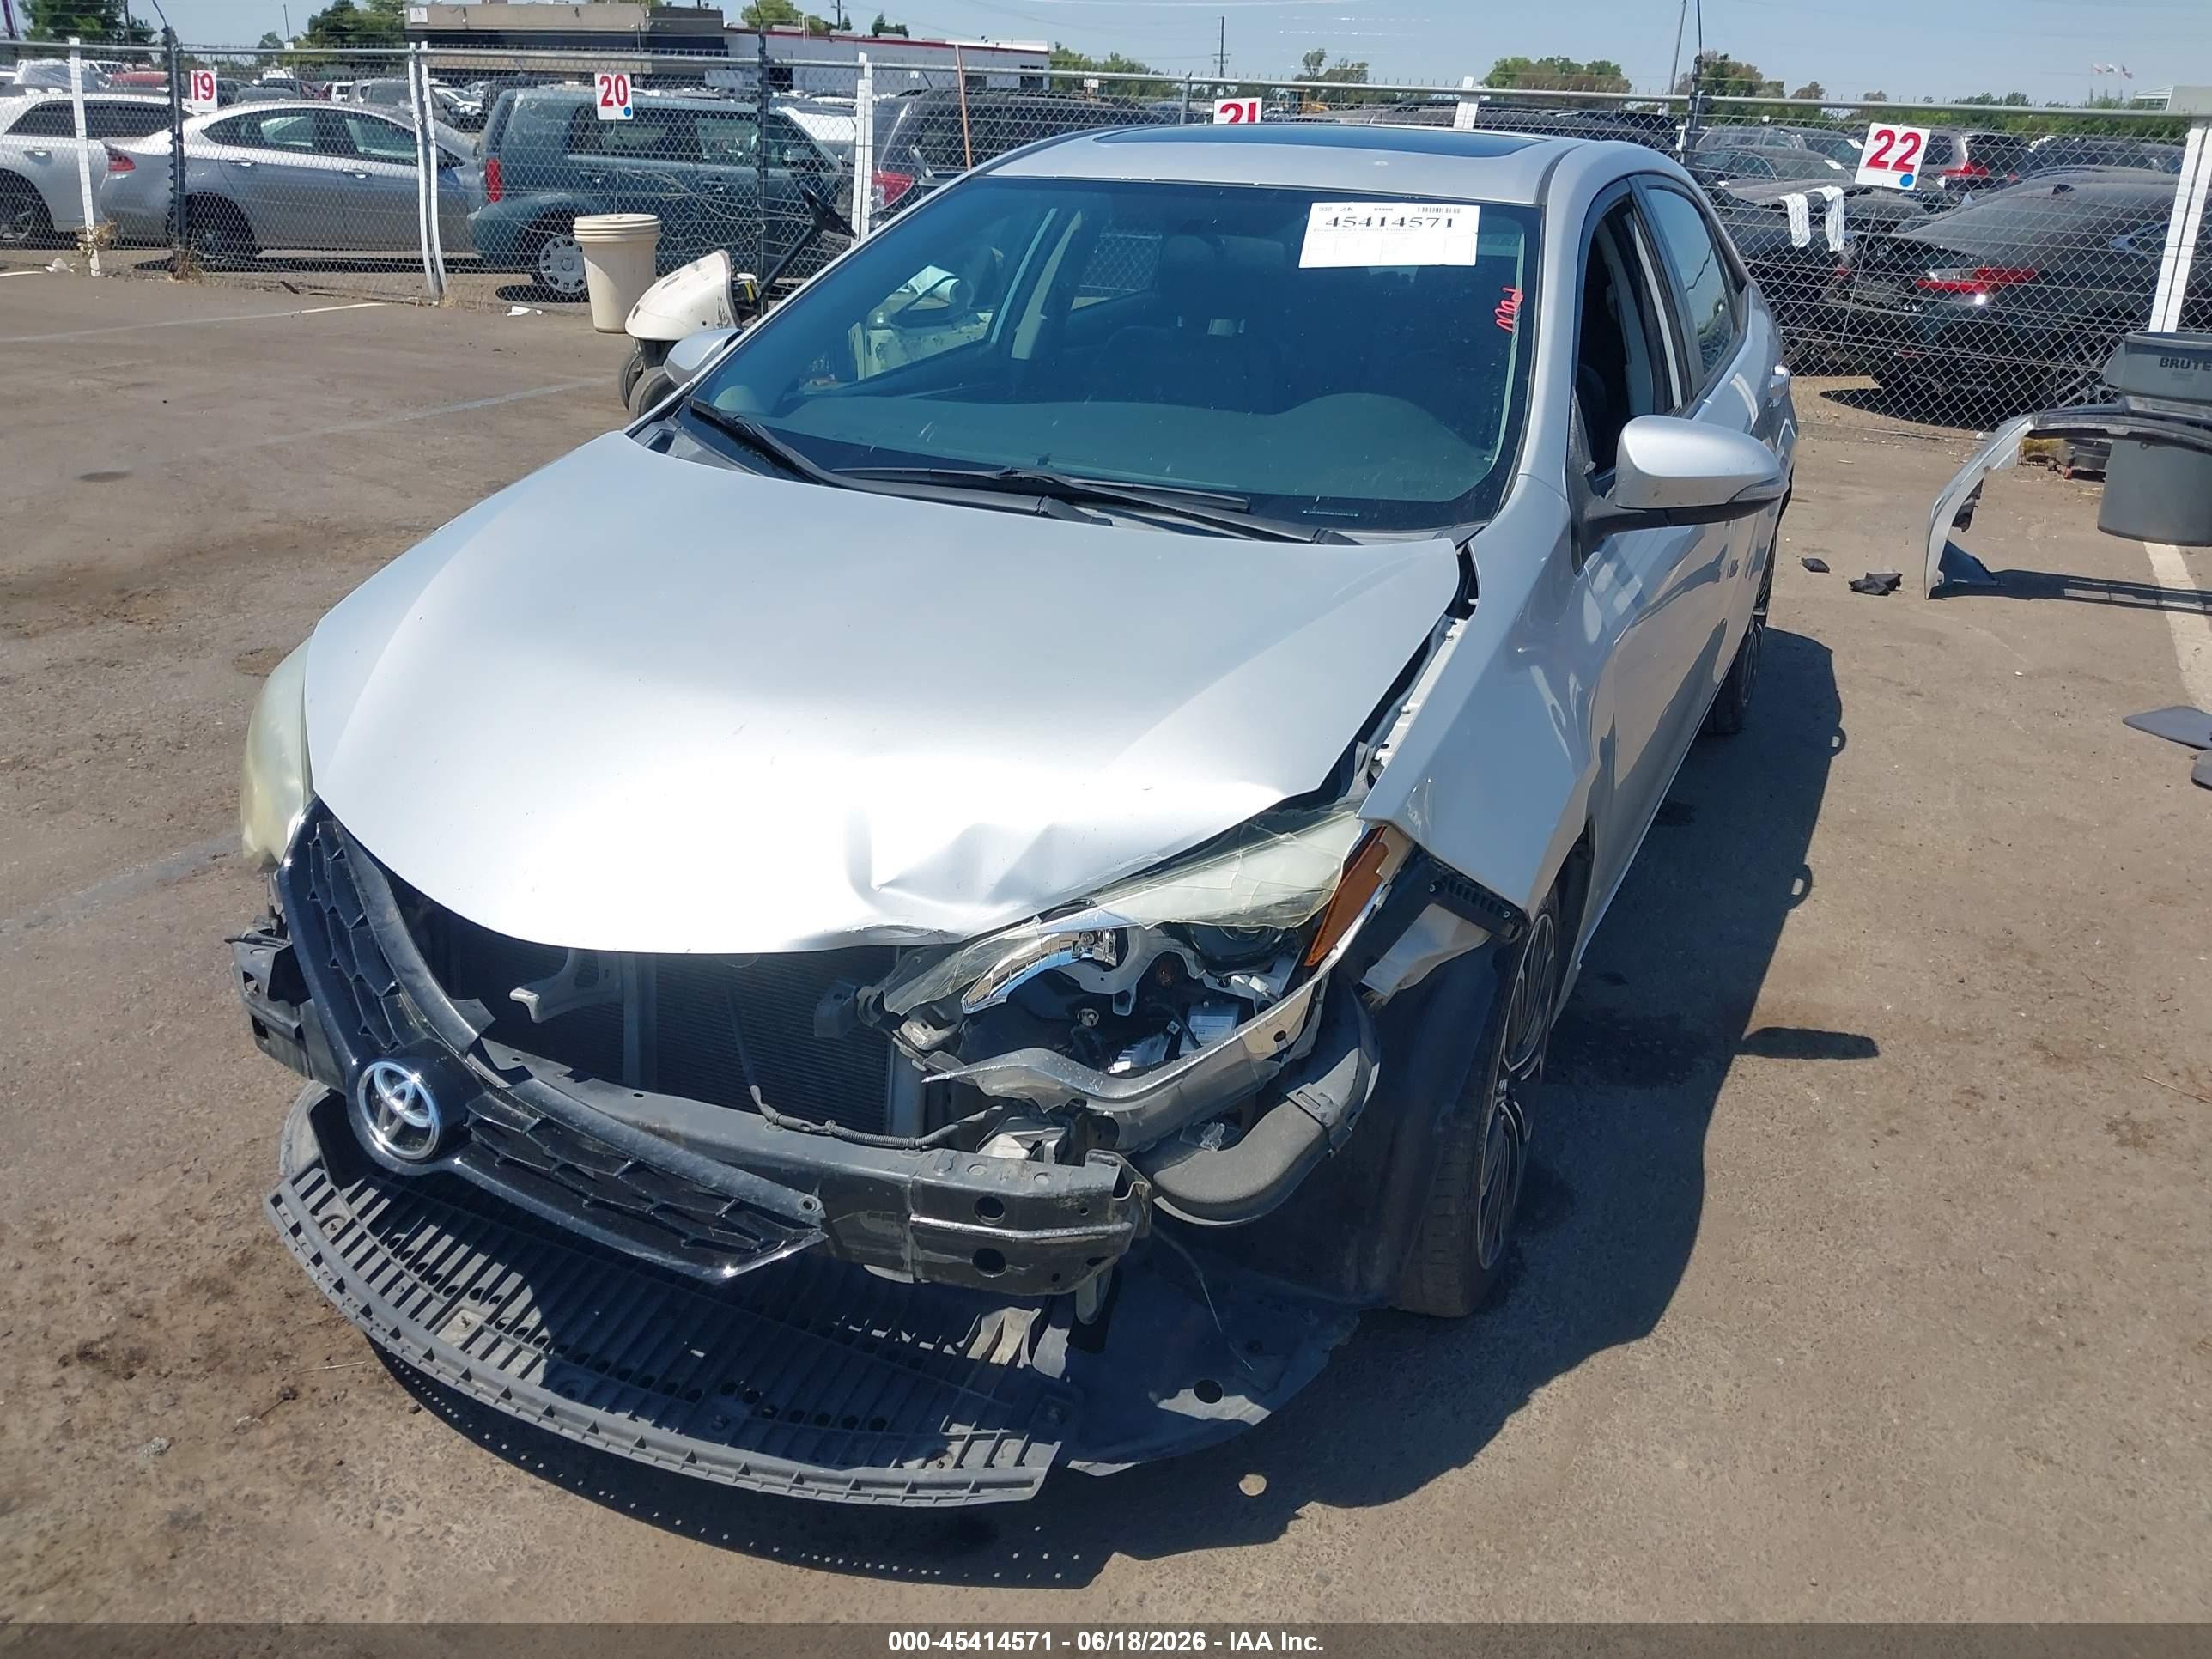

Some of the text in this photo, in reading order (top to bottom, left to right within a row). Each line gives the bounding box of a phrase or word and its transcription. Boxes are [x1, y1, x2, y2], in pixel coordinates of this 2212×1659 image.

[193, 72, 214, 101] 19
[599, 74, 628, 106] 20
[1865, 129, 1921, 173] 22
[1325, 216, 1453, 228] 45414571
[2159, 356, 2212, 372] BRUTE
